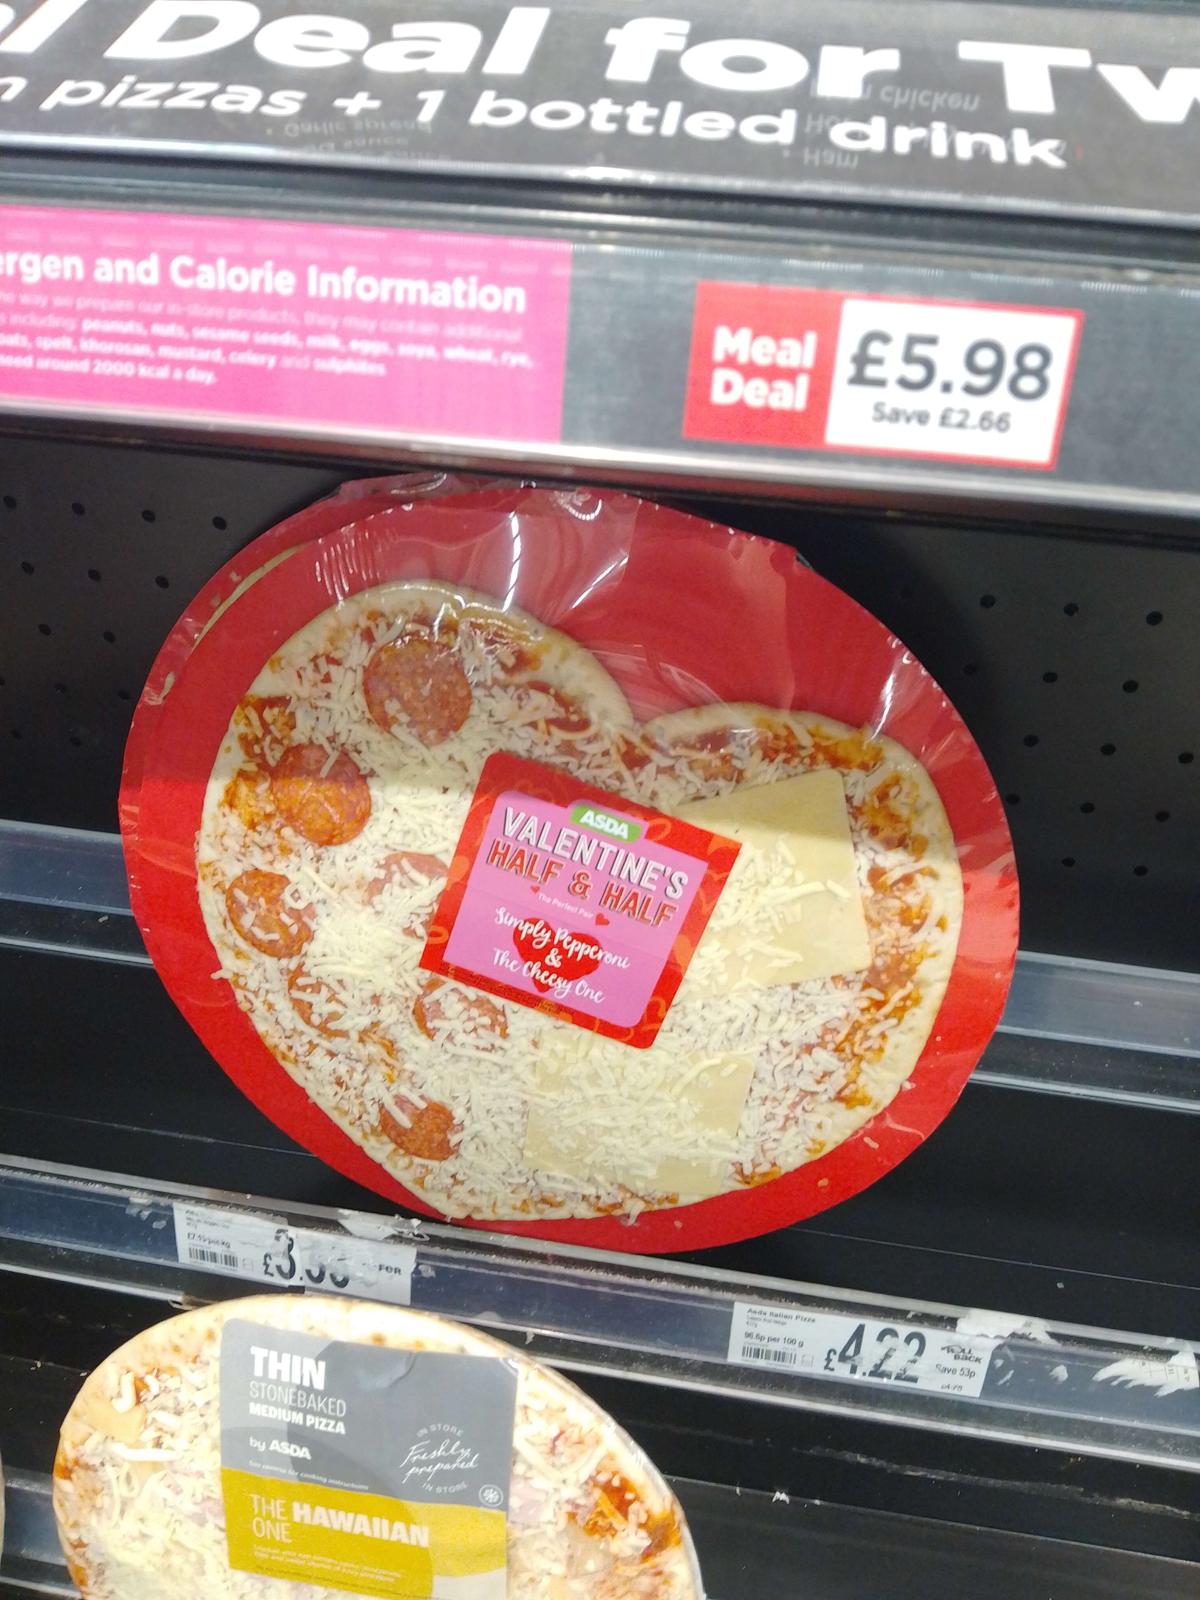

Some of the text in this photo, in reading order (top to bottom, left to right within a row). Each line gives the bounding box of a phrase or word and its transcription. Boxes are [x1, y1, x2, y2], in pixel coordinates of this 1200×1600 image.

[102, 0, 551, 75] Deal
[604, 17, 900, 99] for
[39, 74, 307, 117] pizzas
[334, 90, 381, 117] +
[416, 89, 446, 123] 1
[469, 89, 798, 146] bottled
[829, 115, 1068, 168] drink
[94, 252, 160, 286] and
[169, 255, 296, 295] Calorie
[307, 263, 526, 314] Information
[92, 359, 136, 377] 2000
[712, 325, 818, 369] Meal
[846, 328, 1053, 402] £5.98
[710, 368, 811, 412] Deal
[871, 401, 1011, 433] Save £2.66
[579, 809, 630, 841] ASDA
[502, 806, 689, 900] VALENTINE'S
[486, 838, 679, 929] HALF & HALF
[495, 906, 631, 969] Simply Pepperoni
[544, 948, 563, 969] &
[492, 947, 606, 1004] The Cheesy One
[250, 1345, 327, 1391] THIN
[935, 1363, 976, 1379] Save 53p
[248, 1379, 347, 1418] STONEBAKED
[248, 1400, 347, 1436] MEDIUM PIZZA
[249, 1435, 312, 1461] by ASDA
[399, 1438, 472, 1469] Freshly
[401, 1452, 480, 1484] prepared
[249, 1492, 431, 1549] THE HAWAIIAN
[252, 1516, 293, 1544] ONE
